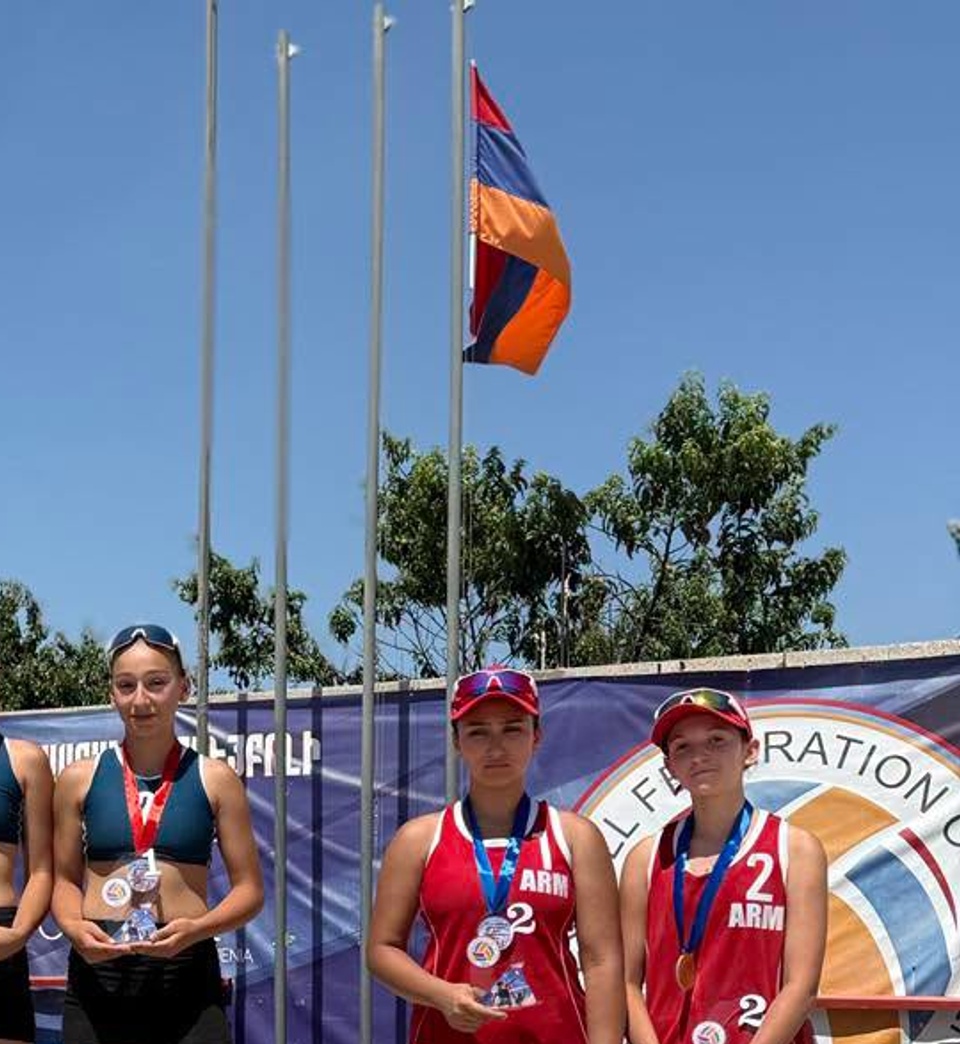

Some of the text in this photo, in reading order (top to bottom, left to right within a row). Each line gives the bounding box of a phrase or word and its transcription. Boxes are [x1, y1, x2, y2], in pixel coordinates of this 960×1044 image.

[632, 730, 949, 814] FERATION
[144, 848, 162, 877] 1
[746, 853, 774, 902] 2
[519, 868, 569, 899] ARM
[506, 902, 536, 934] 2
[728, 903, 785, 932] ARM
[218, 947, 254, 964] ENIA
[738, 994, 767, 1027] 2
